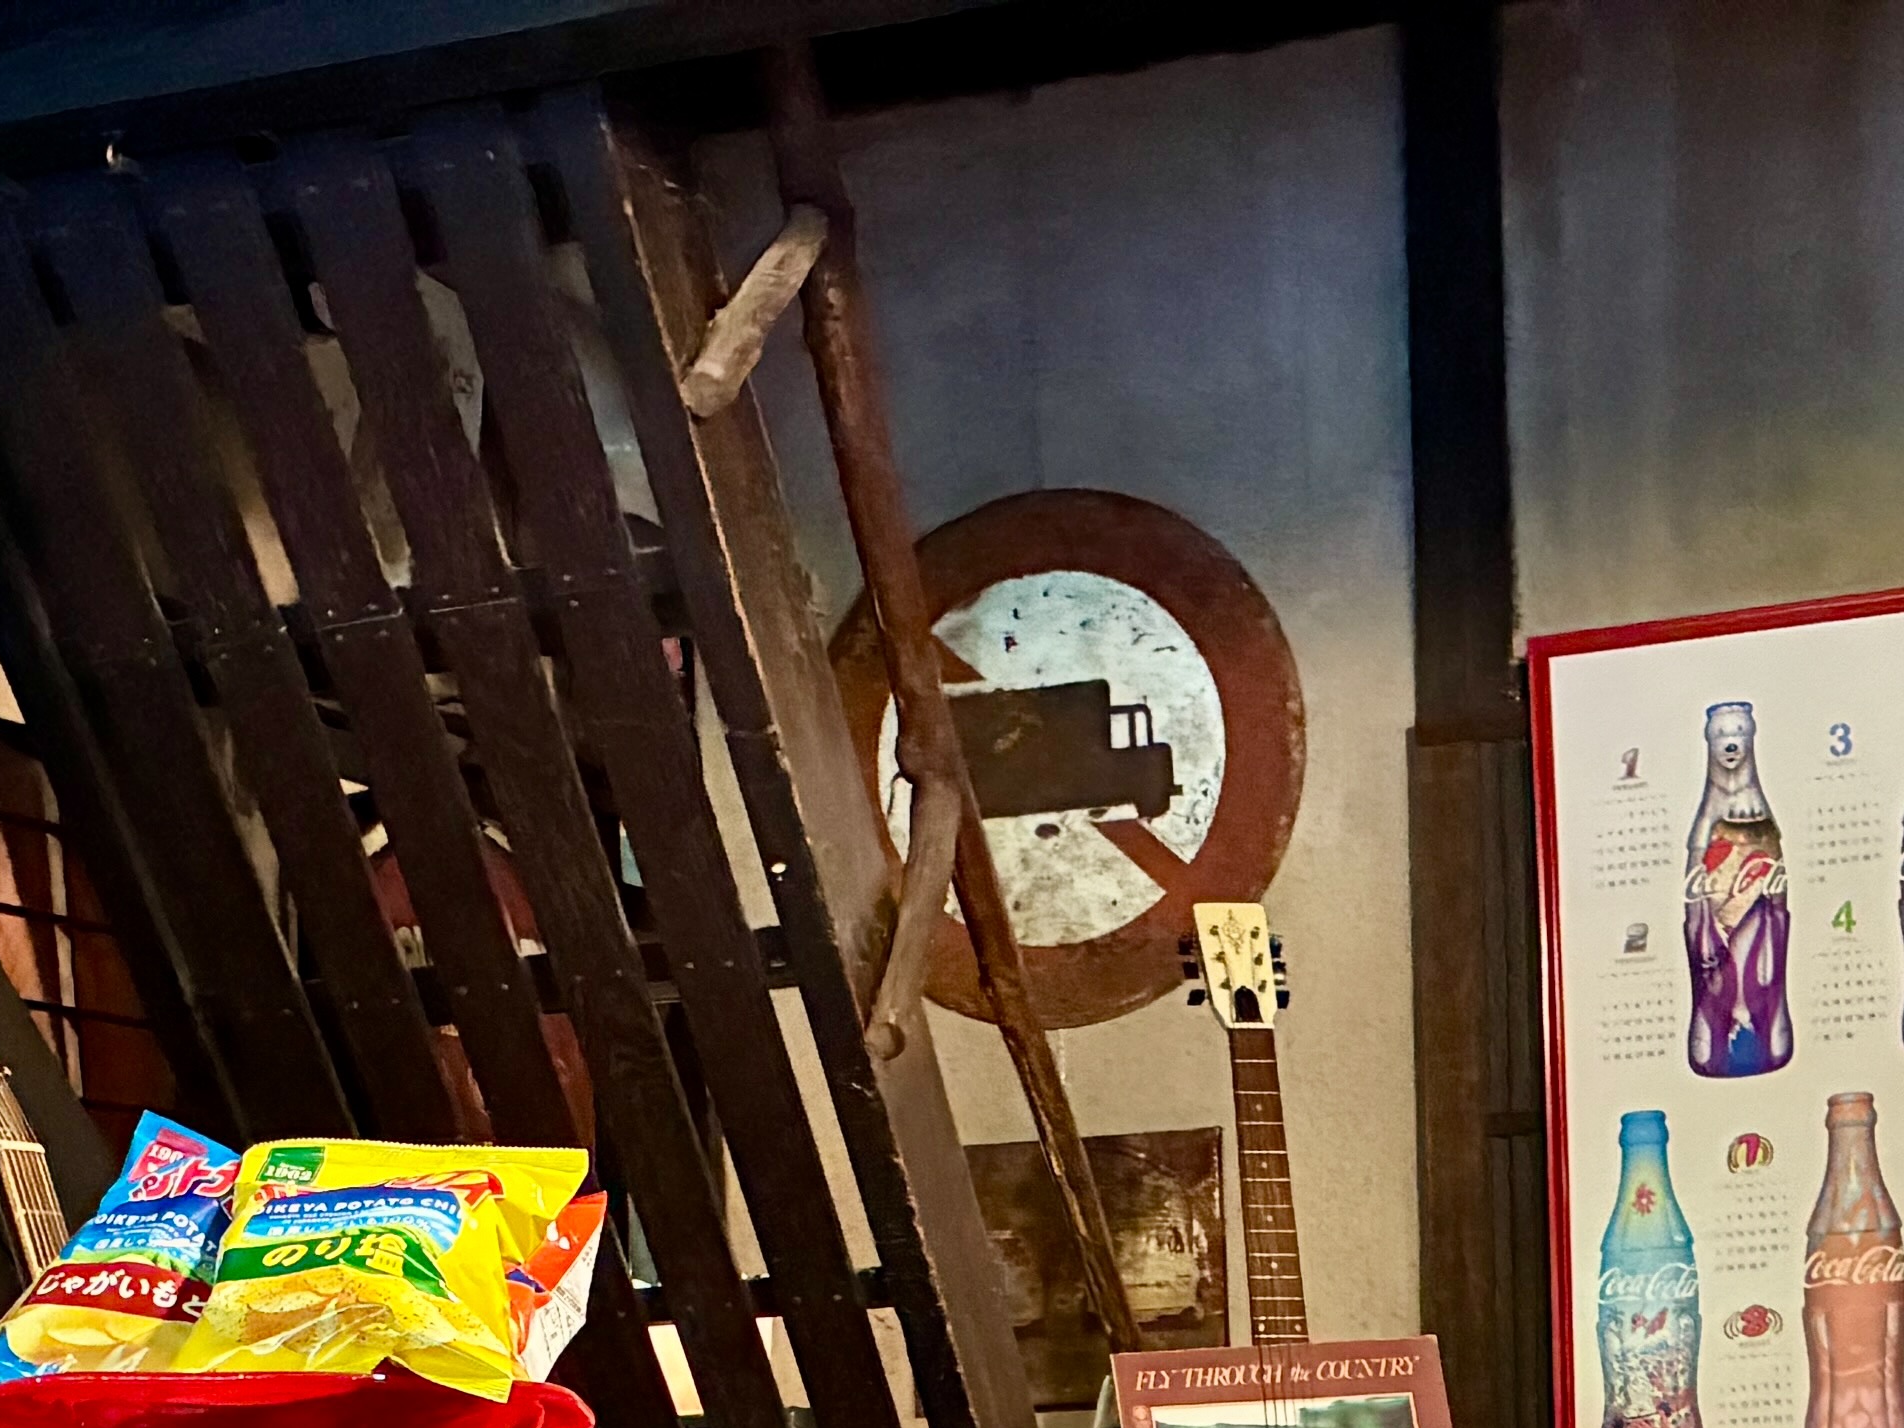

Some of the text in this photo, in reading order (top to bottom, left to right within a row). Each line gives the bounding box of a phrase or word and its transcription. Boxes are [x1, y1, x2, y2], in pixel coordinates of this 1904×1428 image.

[1829, 723, 1853, 757] 3
[1618, 747, 1641, 780] 1
[1831, 900, 1856, 933] 4
[1623, 922, 1649, 953] 2
[1135, 1368, 1180, 1391] FLY
[1182, 1363, 1283, 1389] THROUGH
[1316, 1356, 1420, 1380] COUNTRY
